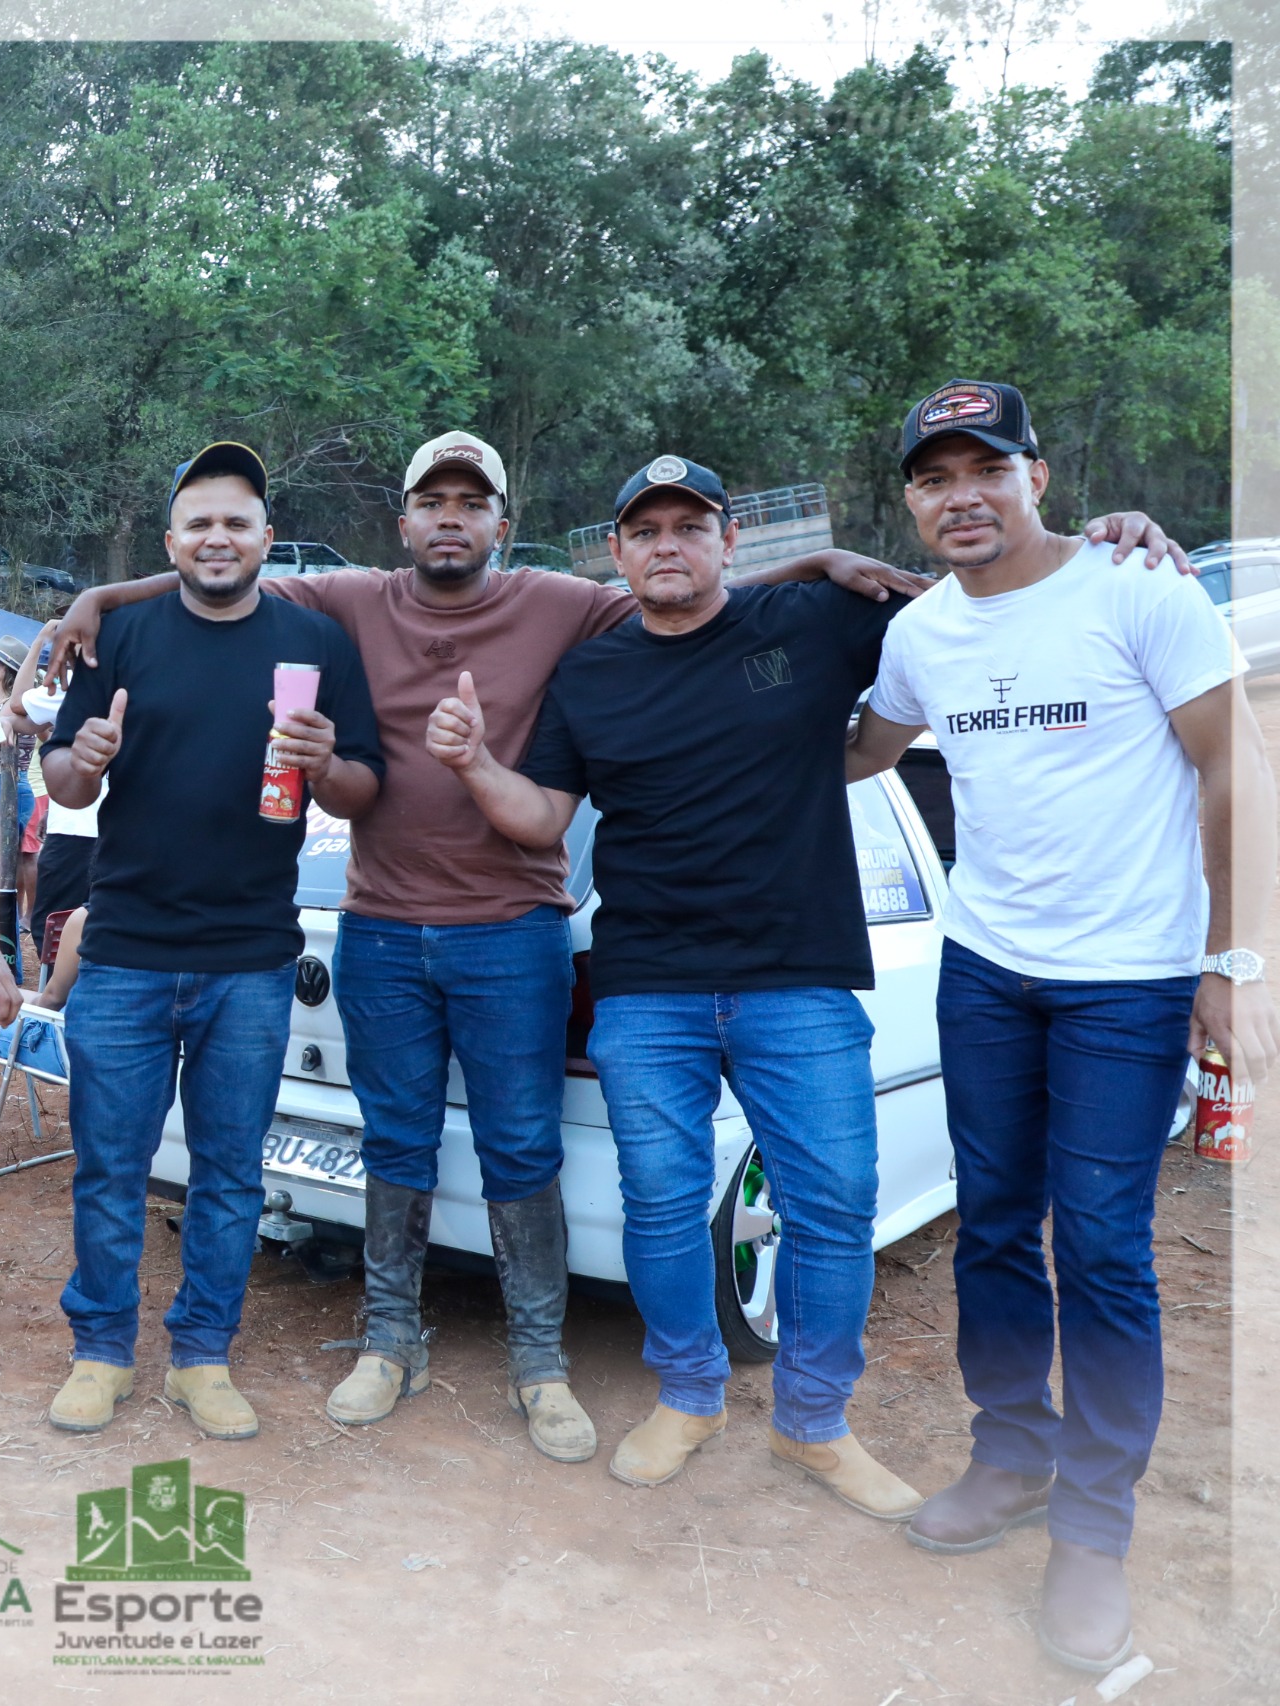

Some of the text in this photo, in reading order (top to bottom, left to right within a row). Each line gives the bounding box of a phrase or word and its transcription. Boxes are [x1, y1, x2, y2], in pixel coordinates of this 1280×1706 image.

[934, 417, 979, 431] WESTERN
[946, 701, 1087, 735] TEXAS FARM
[856, 848, 900, 870] RUNO
[1212, 1103, 1252, 1115] Chopp
